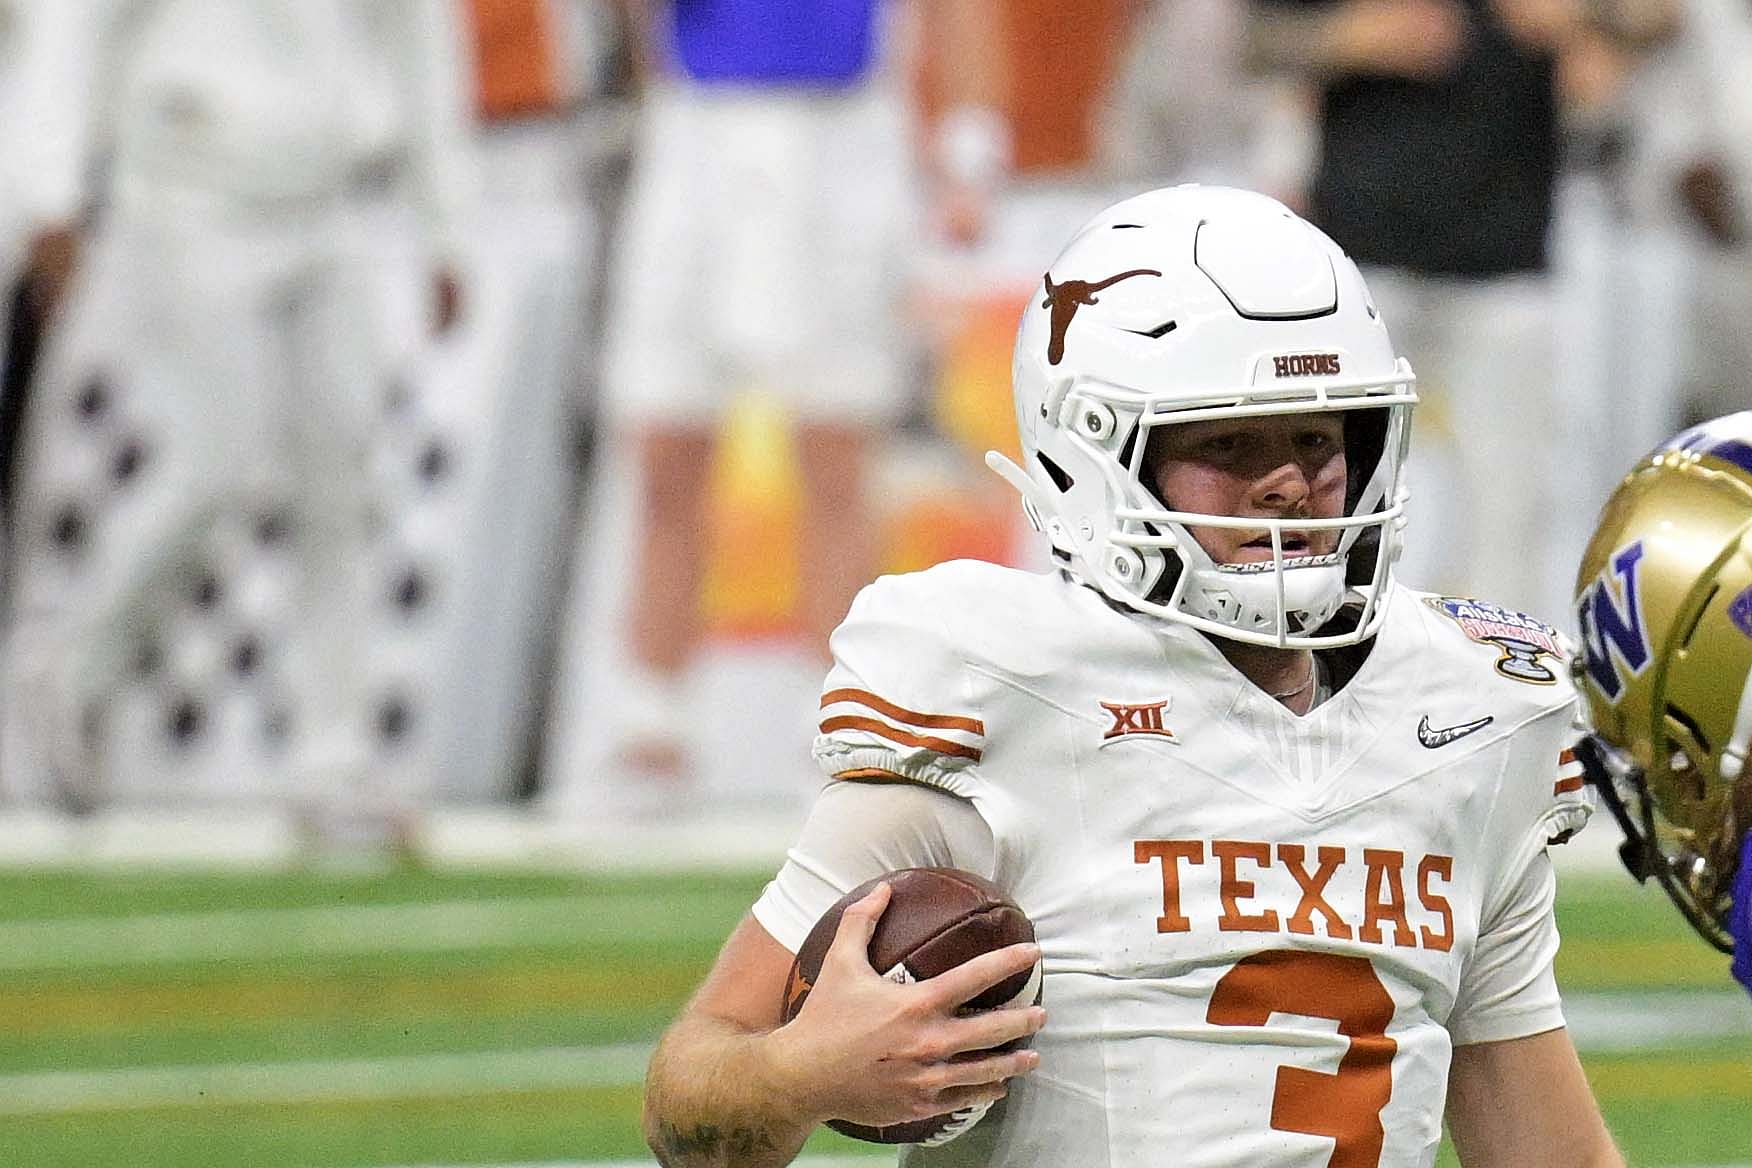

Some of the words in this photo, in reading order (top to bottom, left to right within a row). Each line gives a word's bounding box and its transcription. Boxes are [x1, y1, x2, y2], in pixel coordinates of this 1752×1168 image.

[1272, 353, 1341, 378] HORNS
[1576, 536, 1654, 704] W
[1099, 699, 1174, 741] XII
[1133, 839, 1455, 953] TEXAS
